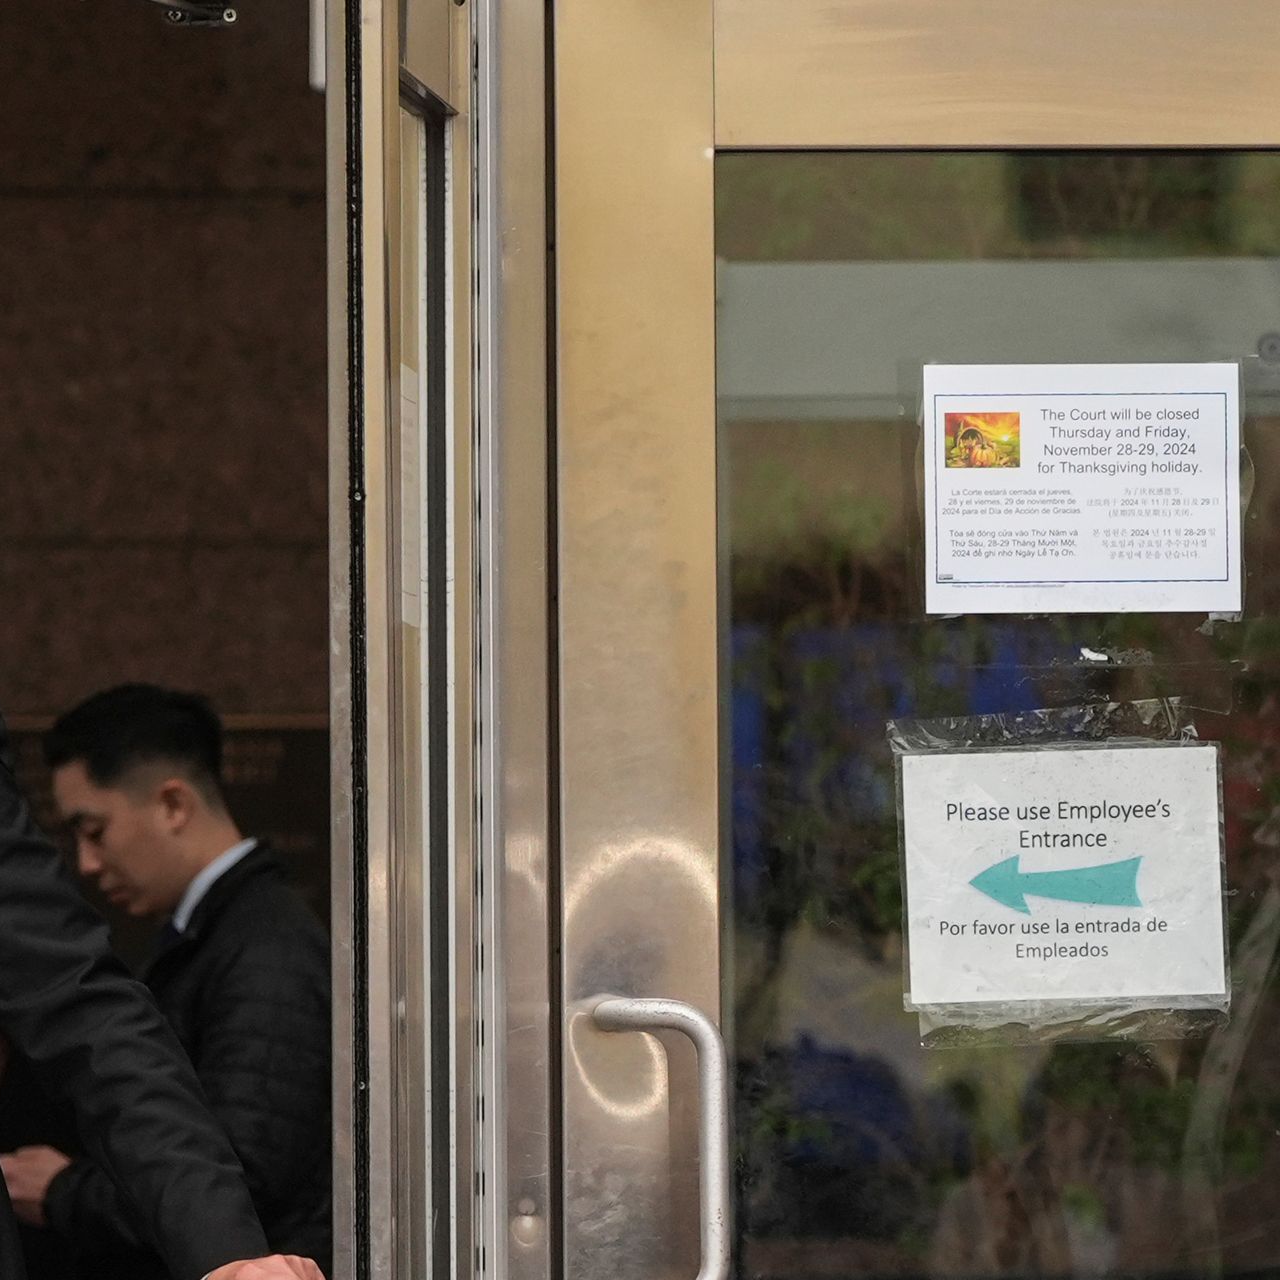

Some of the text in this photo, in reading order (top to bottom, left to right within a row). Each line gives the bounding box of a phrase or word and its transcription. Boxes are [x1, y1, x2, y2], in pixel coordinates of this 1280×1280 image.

[1040, 408, 1199, 421] The Court will be closed
[1049, 425, 1190, 441] Thursday and Friday,
[1044, 443, 1196, 456] November 28-29, 2024
[1038, 460, 1202, 476] for Thanksgiving holiday.
[1009, 488, 1037, 496] cerrada
[1038, 488, 1046, 496] el
[959, 499, 964, 507] y
[1004, 497, 1014, 505] 29
[1015, 497, 1025, 505] de
[1027, 497, 1065, 505] noviembre
[1067, 497, 1077, 505] de
[942, 507, 961, 515] 2024
[980, 507, 987, 515] el
[1003, 507, 1013, 515] de
[987, 539, 1010, 547] 28-29
[952, 549, 970, 557] 2024
[947, 799, 1170, 823] Please use Employee's
[1020, 830, 1107, 848] Entrance
[940, 917, 1168, 935] Por favor use la entrada de
[1016, 943, 1109, 960] Empleados
